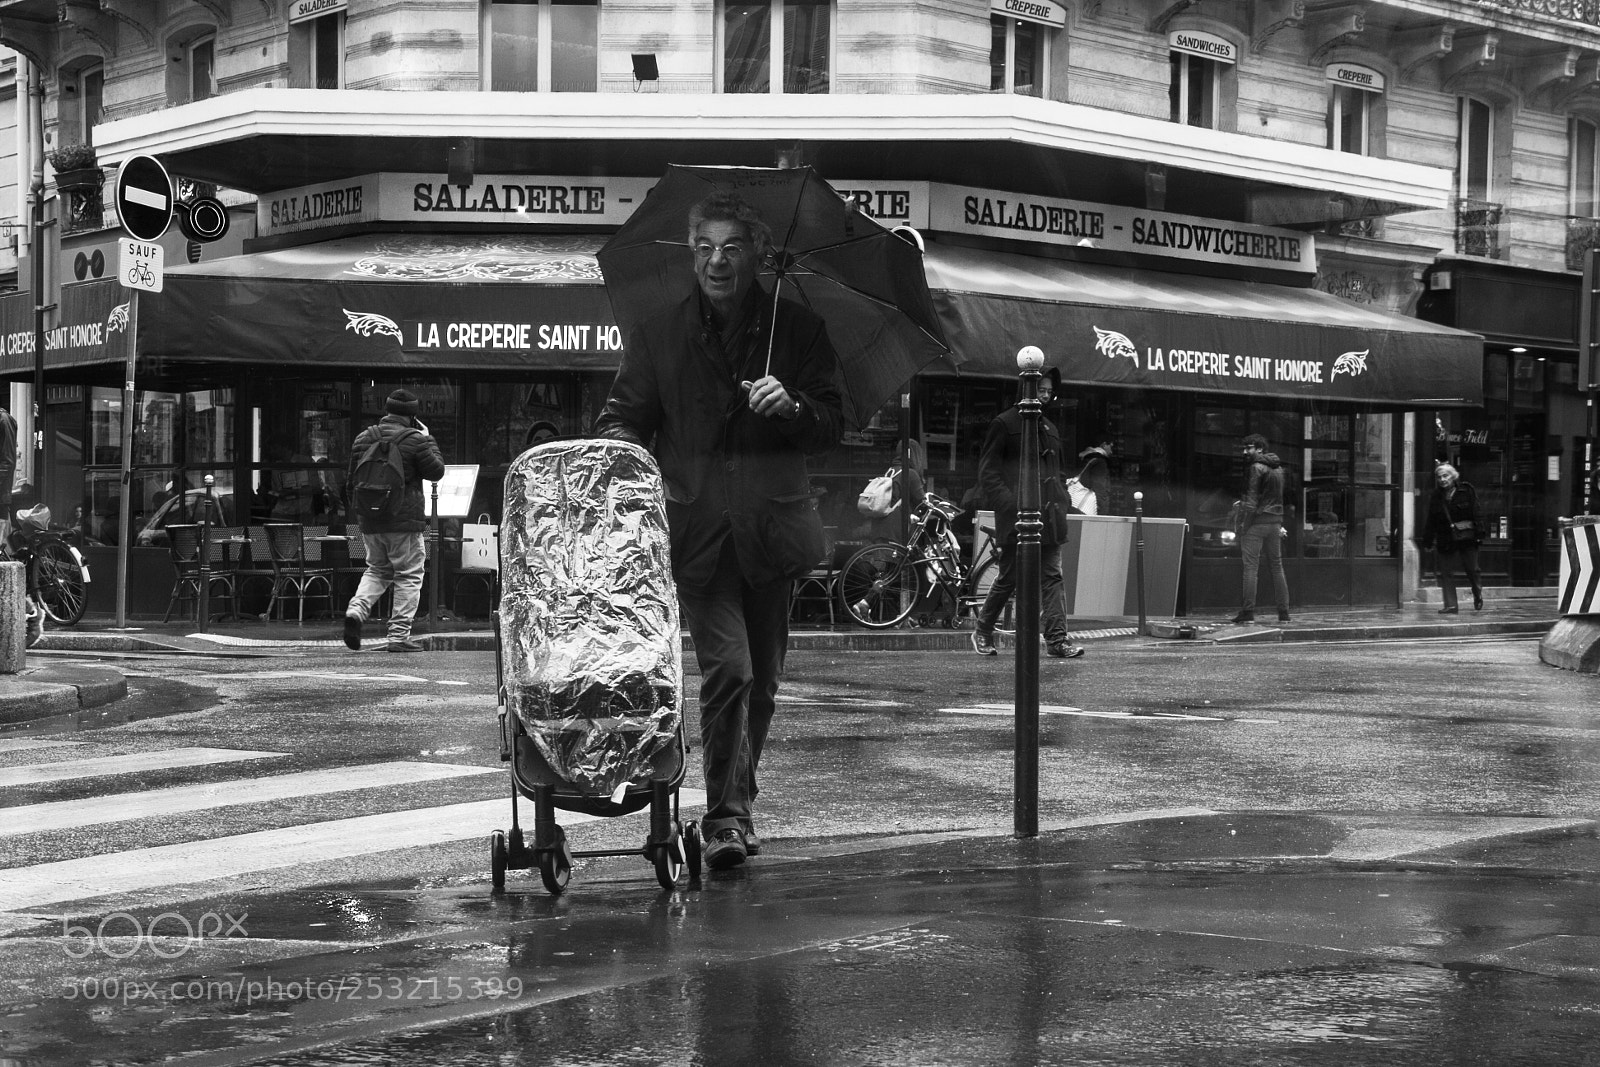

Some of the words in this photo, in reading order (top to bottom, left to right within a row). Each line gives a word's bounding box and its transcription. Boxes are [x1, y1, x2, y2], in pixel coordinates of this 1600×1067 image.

[1005, 0, 1051, 18] CREPERIE
[1176, 34, 1230, 56] SANDWICHES
[1337, 68, 1373, 85] CREPERIE
[271, 186, 363, 227] SALADERIE
[413, 183, 605, 215] SALADERIE
[964, 195, 1104, 240] SALADERIE
[1131, 217, 1301, 263] SANDWICHERIE
[129, 243, 157, 259] SAUF
[7, 331, 36, 355] CREPER
[44, 326, 68, 350] SAINT
[69, 322, 103, 348] HONORE
[417, 323, 440, 348] LA
[446, 323, 531, 349] CREPERIE
[538, 324, 591, 350] SAINT
[596, 325, 624, 350] HO
[1147, 347, 1165, 371] LA
[1168, 349, 1230, 376] CREPERIE
[1234, 355, 1271, 380] SAINT
[1275, 358, 1323, 383] HONORE
